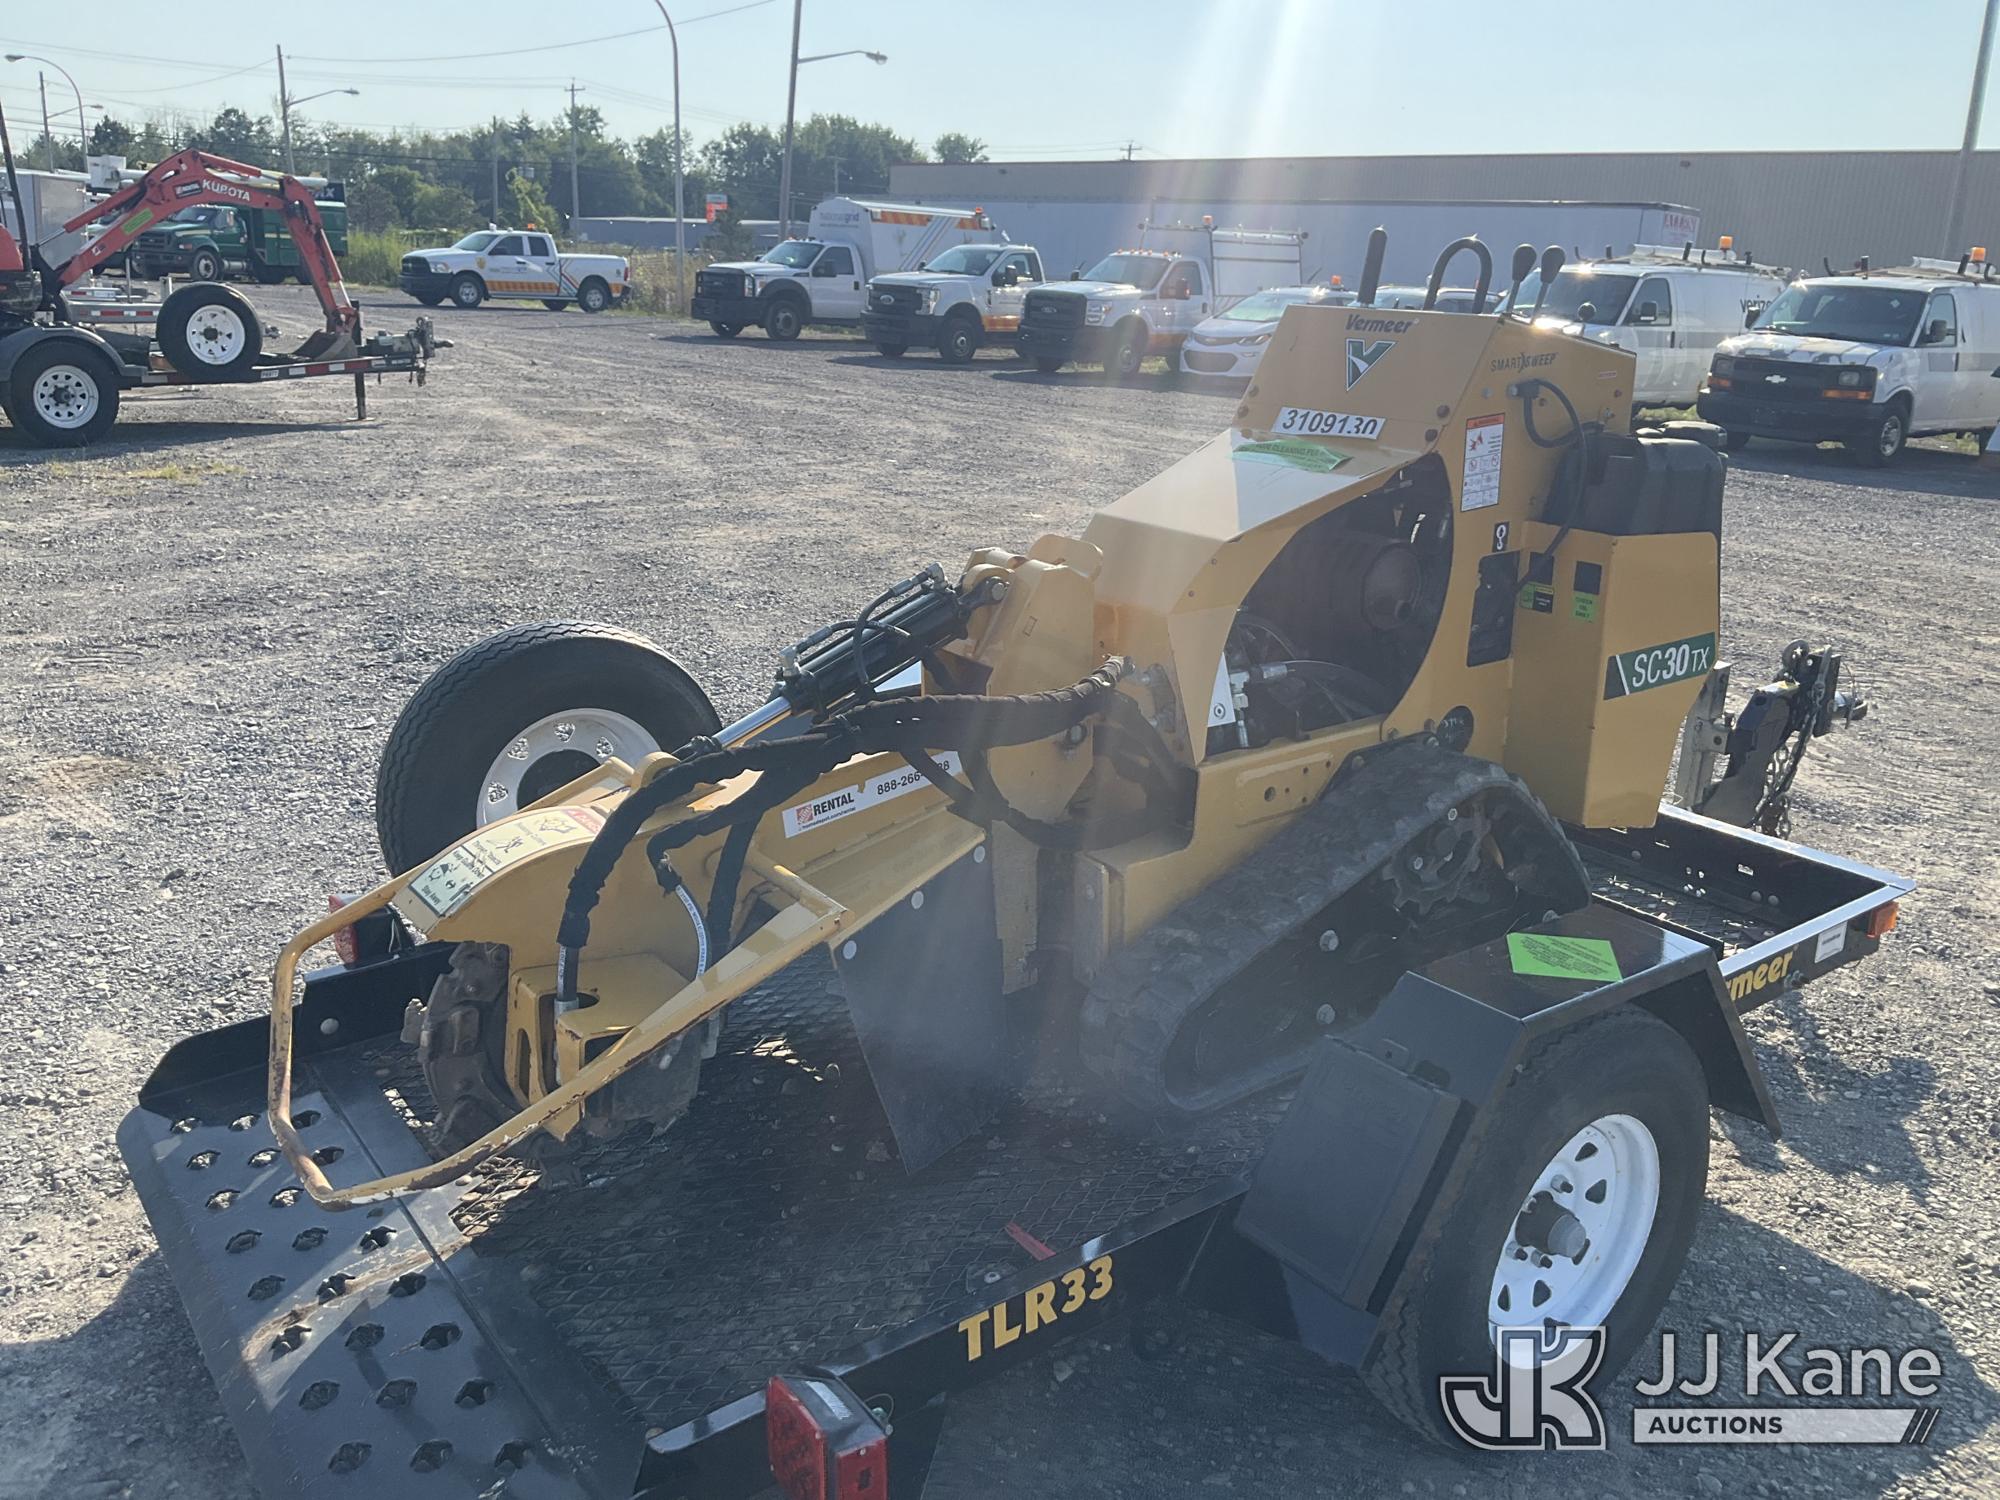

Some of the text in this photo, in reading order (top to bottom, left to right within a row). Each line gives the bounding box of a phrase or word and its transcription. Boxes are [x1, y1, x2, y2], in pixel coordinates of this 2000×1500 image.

[202, 178, 250, 201] KUBOTA
[1740, 298, 1773, 313] veriz
[1345, 313, 1413, 334] Vermeer
[1282, 409, 1378, 434] 3109130
[813, 791, 855, 817] RENTAL
[1725, 951, 1793, 1001] meer
[958, 1255, 1113, 1362] TLR33
